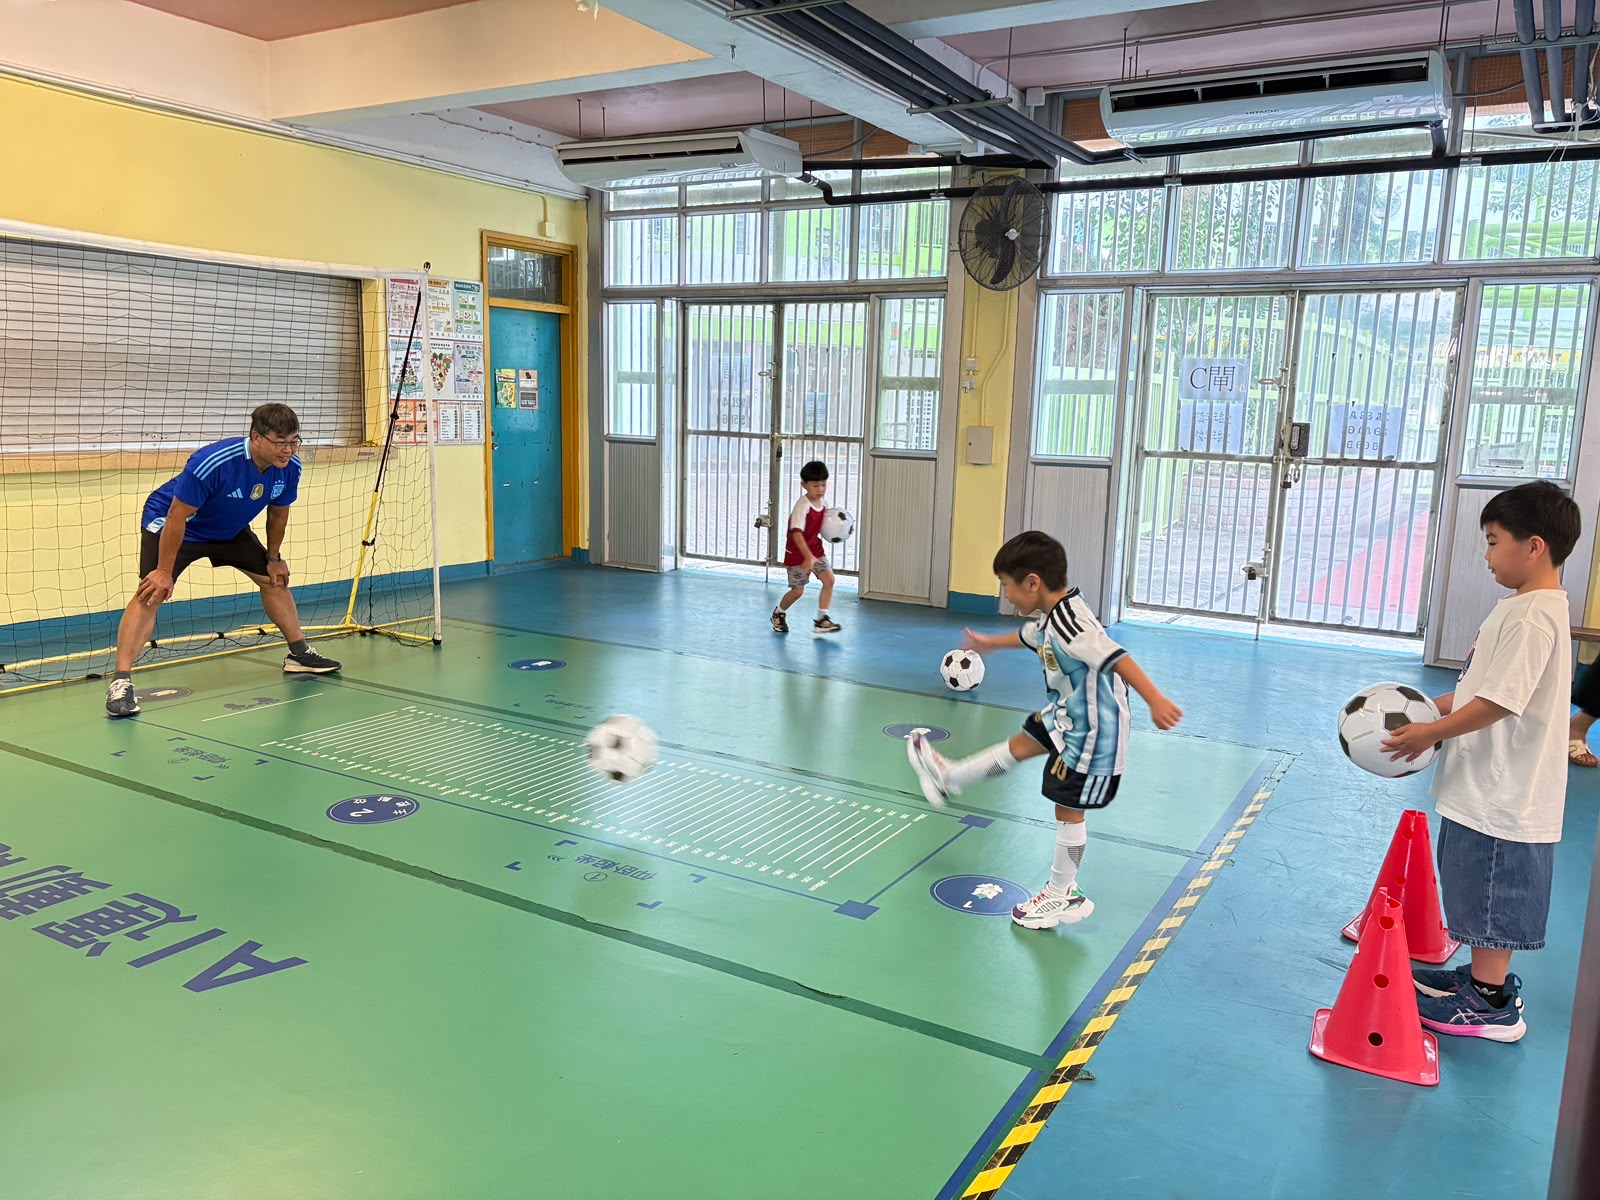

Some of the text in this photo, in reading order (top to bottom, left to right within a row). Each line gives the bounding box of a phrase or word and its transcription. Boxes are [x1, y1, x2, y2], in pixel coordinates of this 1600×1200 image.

[1190, 366, 1235, 391] C閘
[1050, 755, 1067, 781] 10
[350, 808, 375, 817] 2
